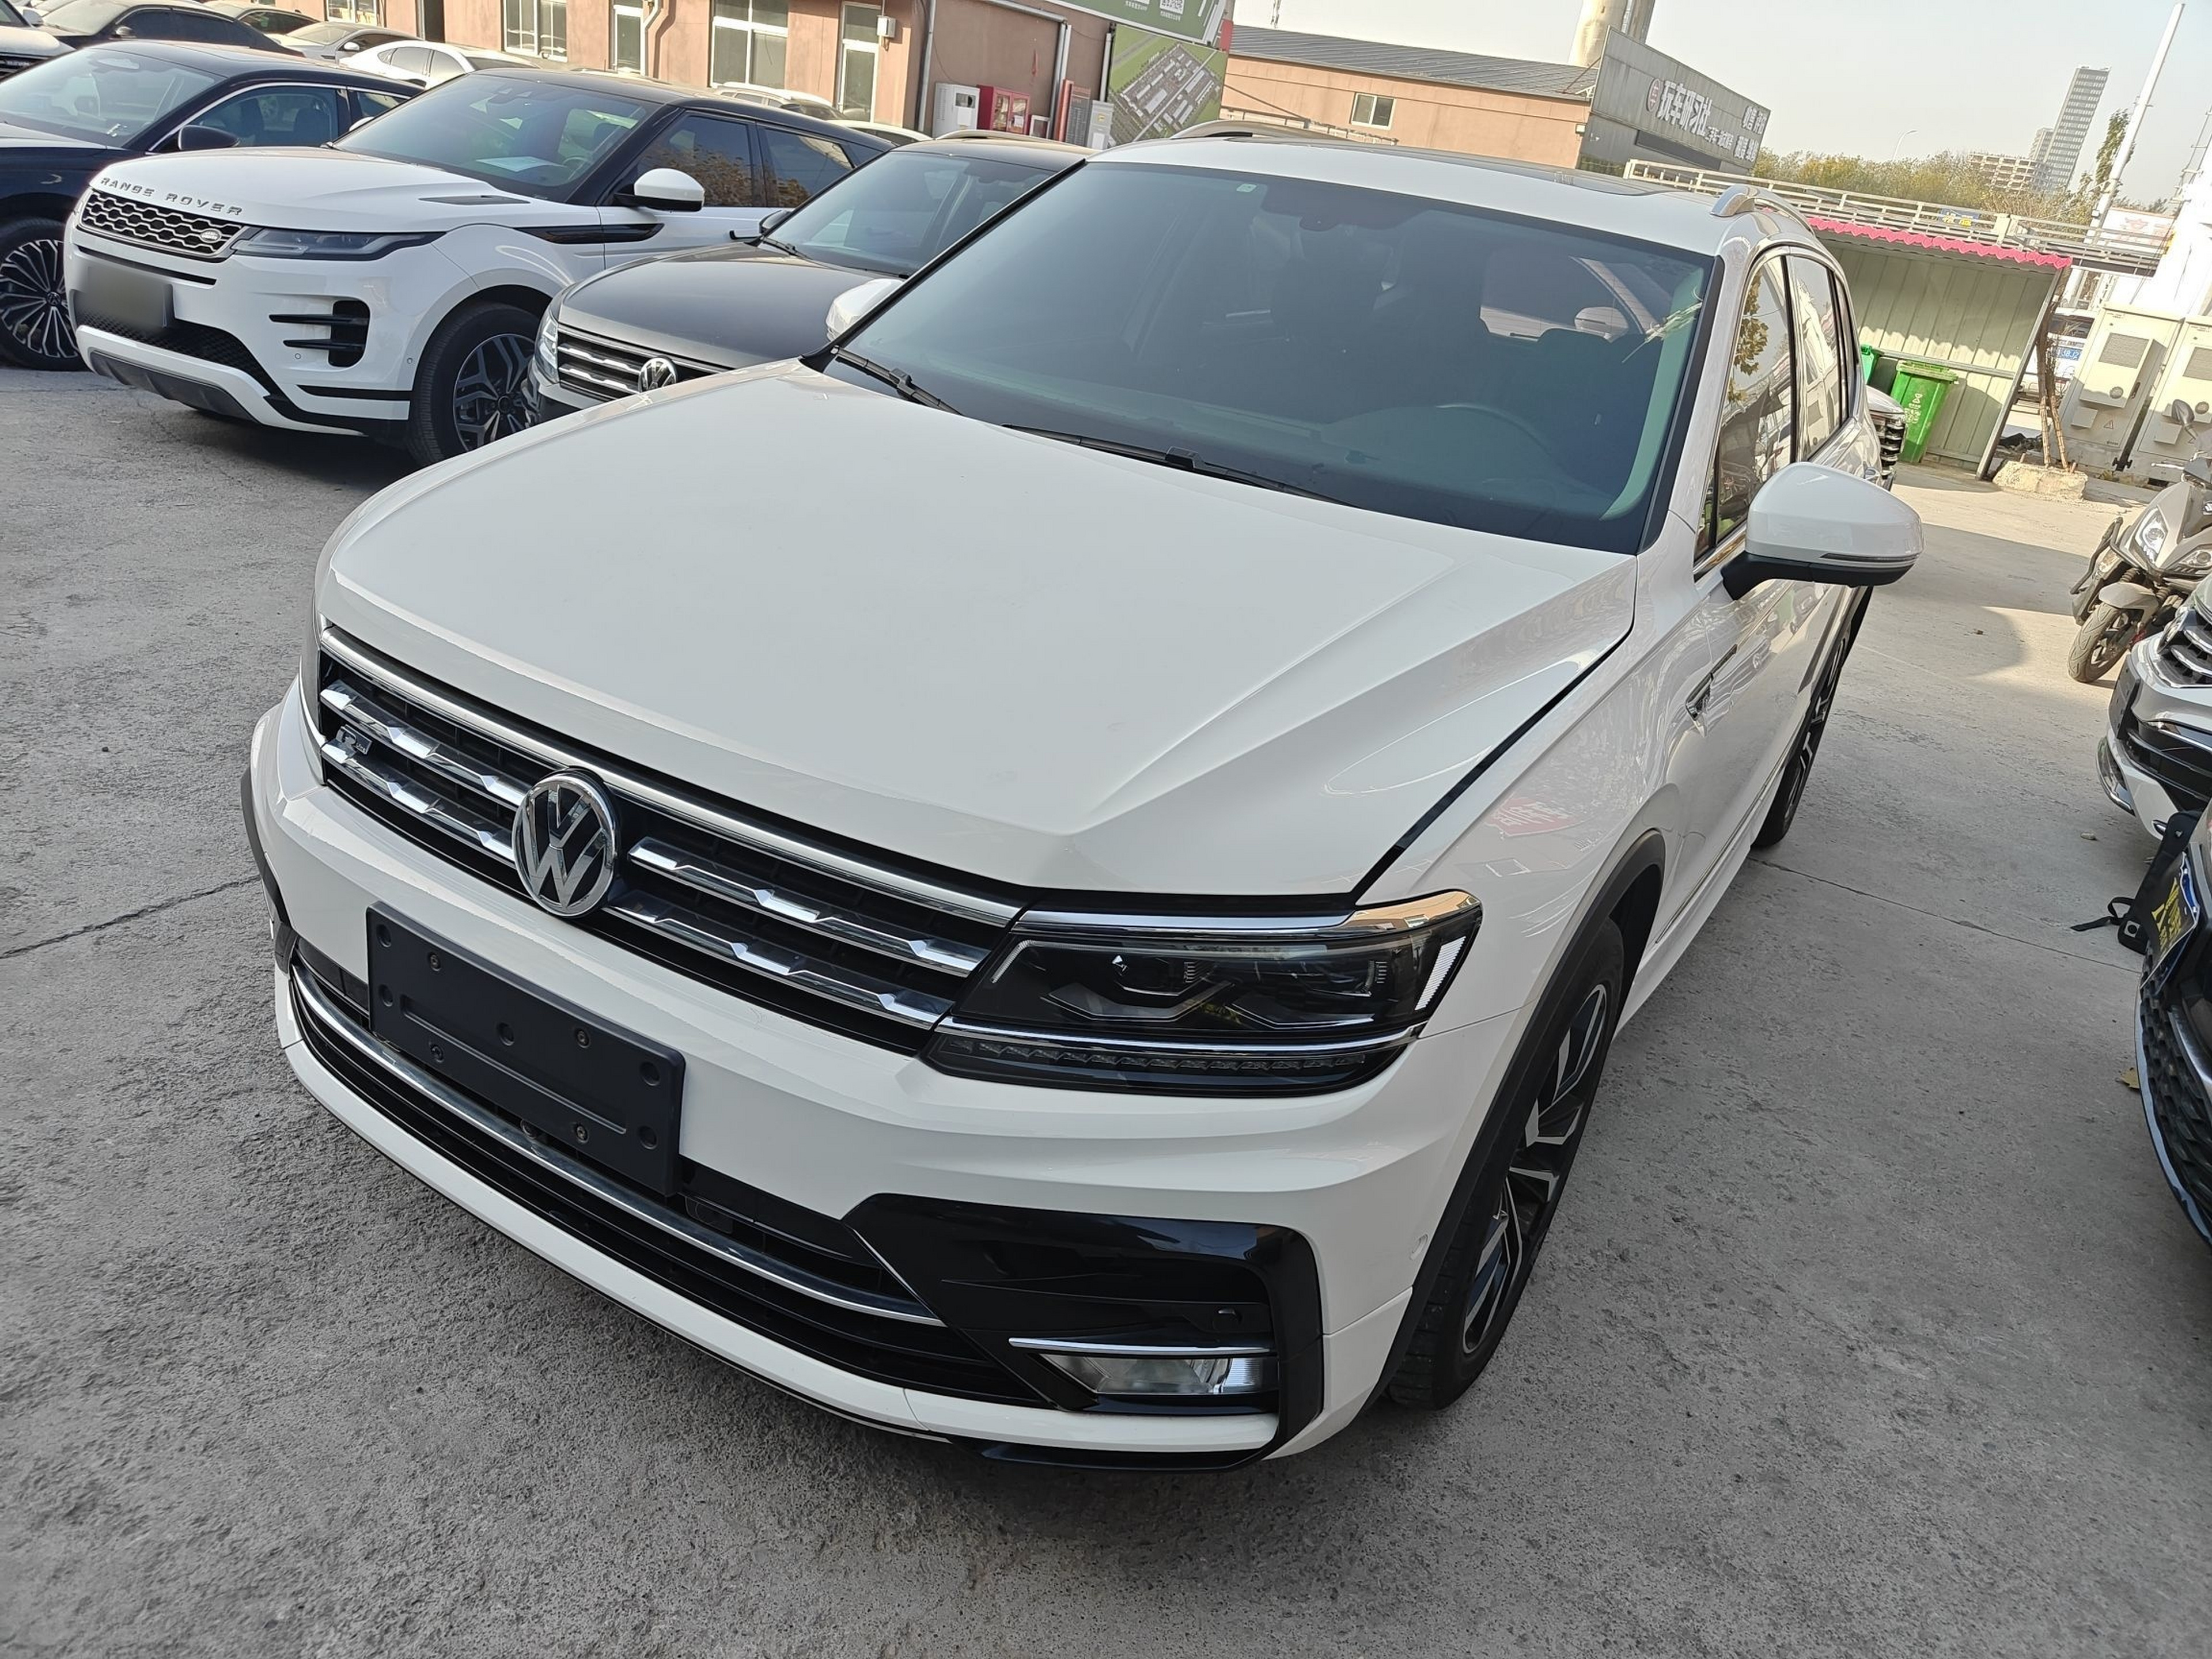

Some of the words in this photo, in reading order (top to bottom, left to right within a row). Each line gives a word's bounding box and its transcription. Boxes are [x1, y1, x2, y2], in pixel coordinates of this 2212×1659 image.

[1657, 81, 1712, 137] 玩车研习社
[101, 177, 154, 196] RANGE
[165, 193, 242, 215] ROVER
[515, 778, 612, 914] VW
